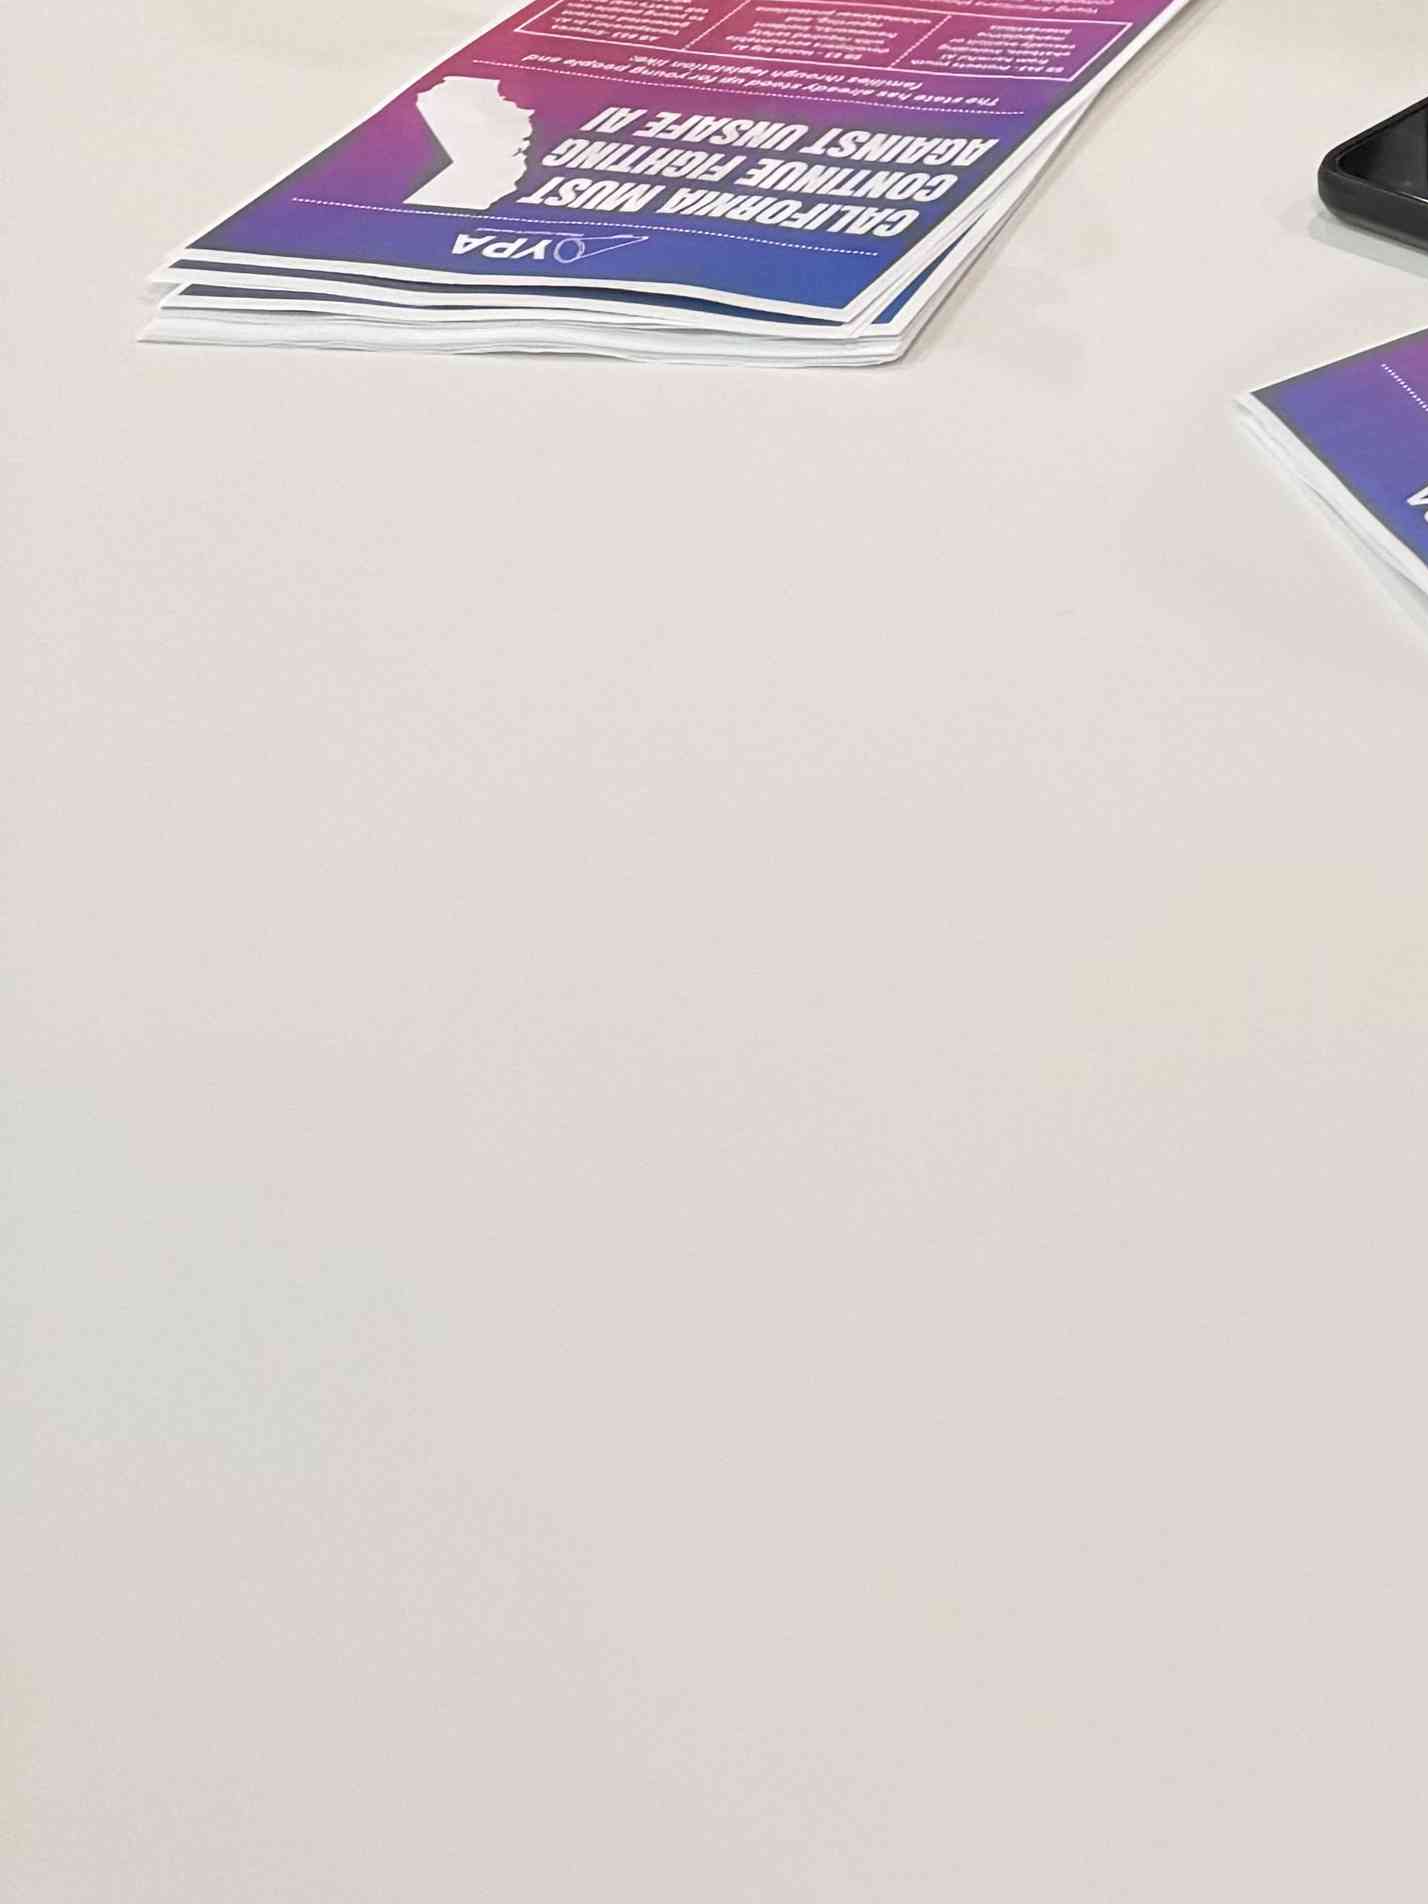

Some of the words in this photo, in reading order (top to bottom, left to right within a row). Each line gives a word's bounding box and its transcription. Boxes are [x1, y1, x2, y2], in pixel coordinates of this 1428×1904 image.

[581, 107, 647, 133] AI
[633, 112, 808, 151] UNSAFE
[542, 139, 746, 181] FIGHTING
[799, 128, 999, 166] AGAINST
[517, 177, 665, 212] MUST
[734, 159, 958, 201] CONTINUE
[656, 188, 919, 236] CALIFORNIA
[452, 234, 564, 259] YPA
